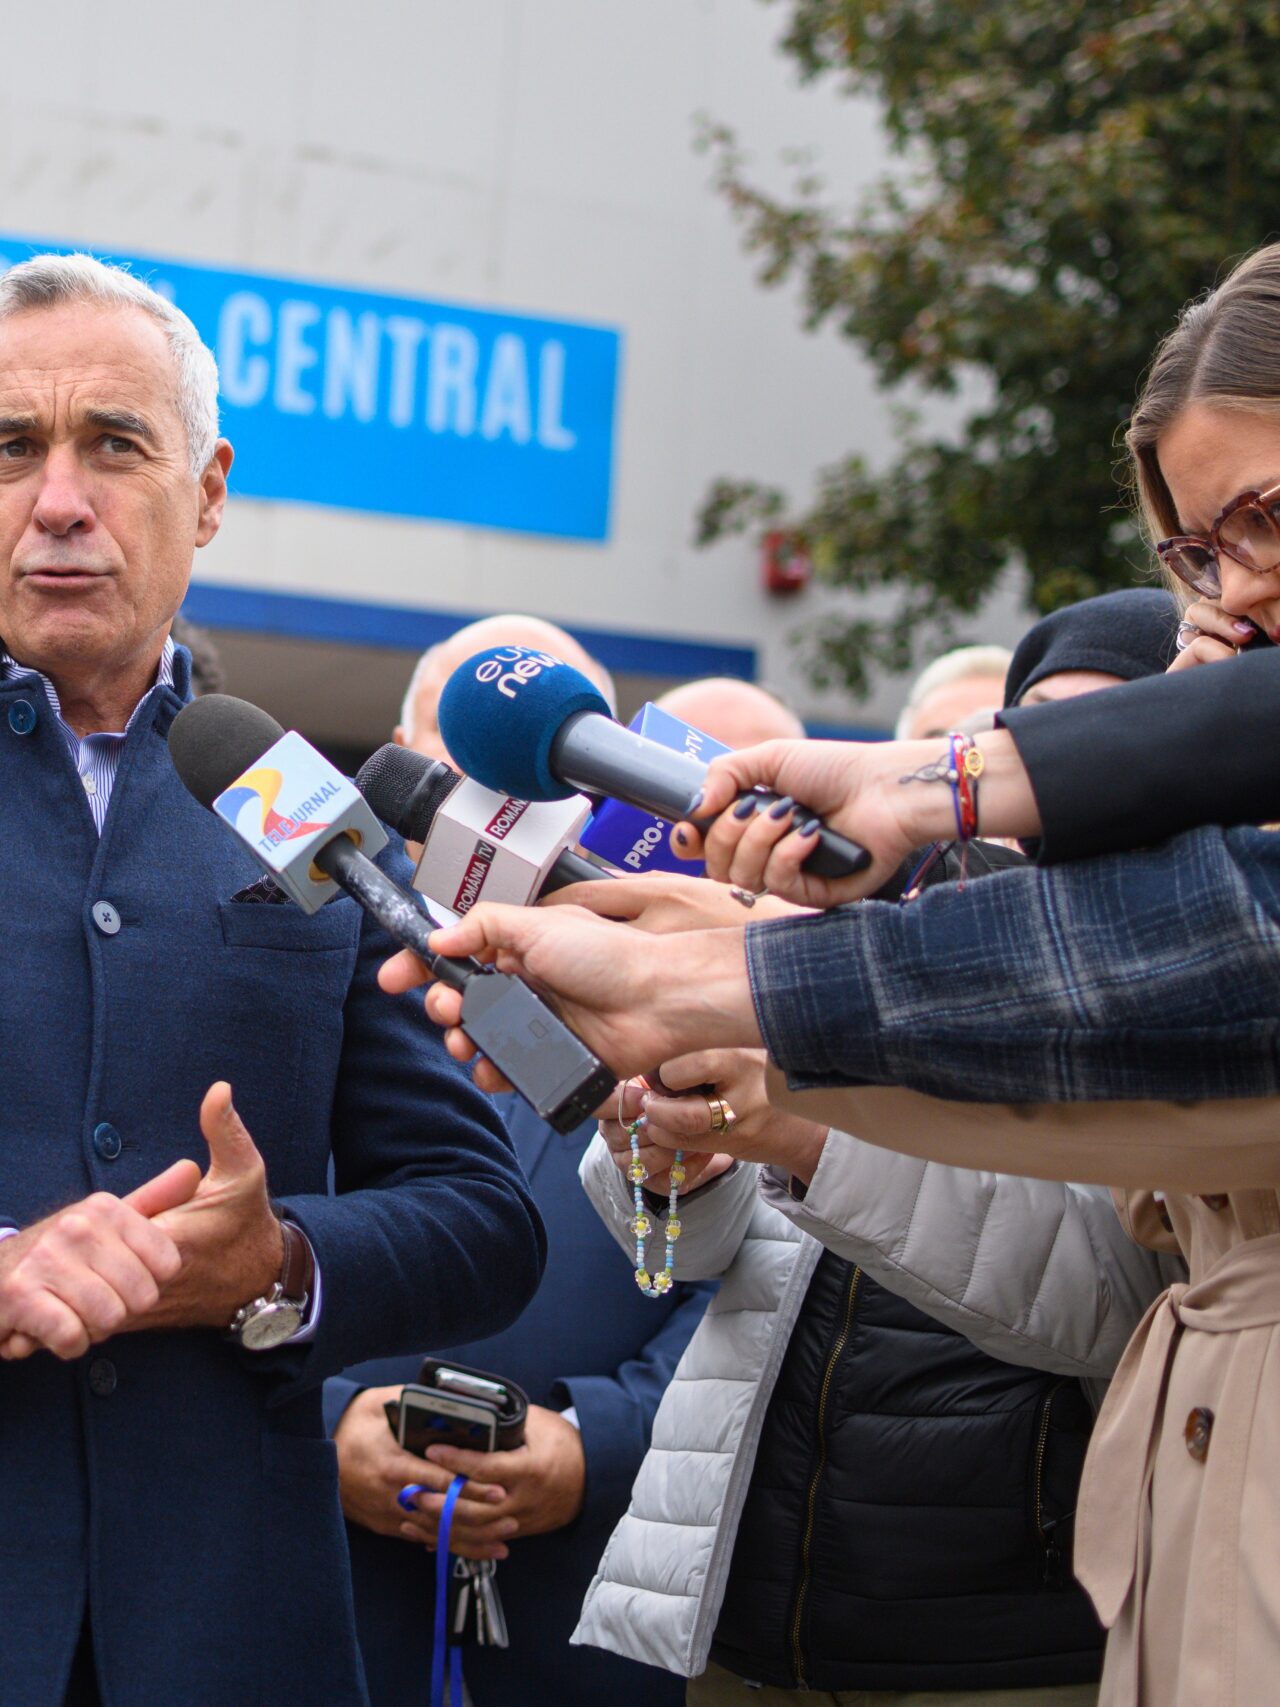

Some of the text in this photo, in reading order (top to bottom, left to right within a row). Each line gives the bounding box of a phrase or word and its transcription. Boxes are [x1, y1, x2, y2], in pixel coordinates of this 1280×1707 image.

[218, 289, 577, 450] CENTRAL
[497, 653, 566, 698] new
[258, 780, 342, 853] TELEJURNAL
[489, 800, 528, 838] ROMÂN
[457, 842, 493, 914] ROMÂNIA TV
